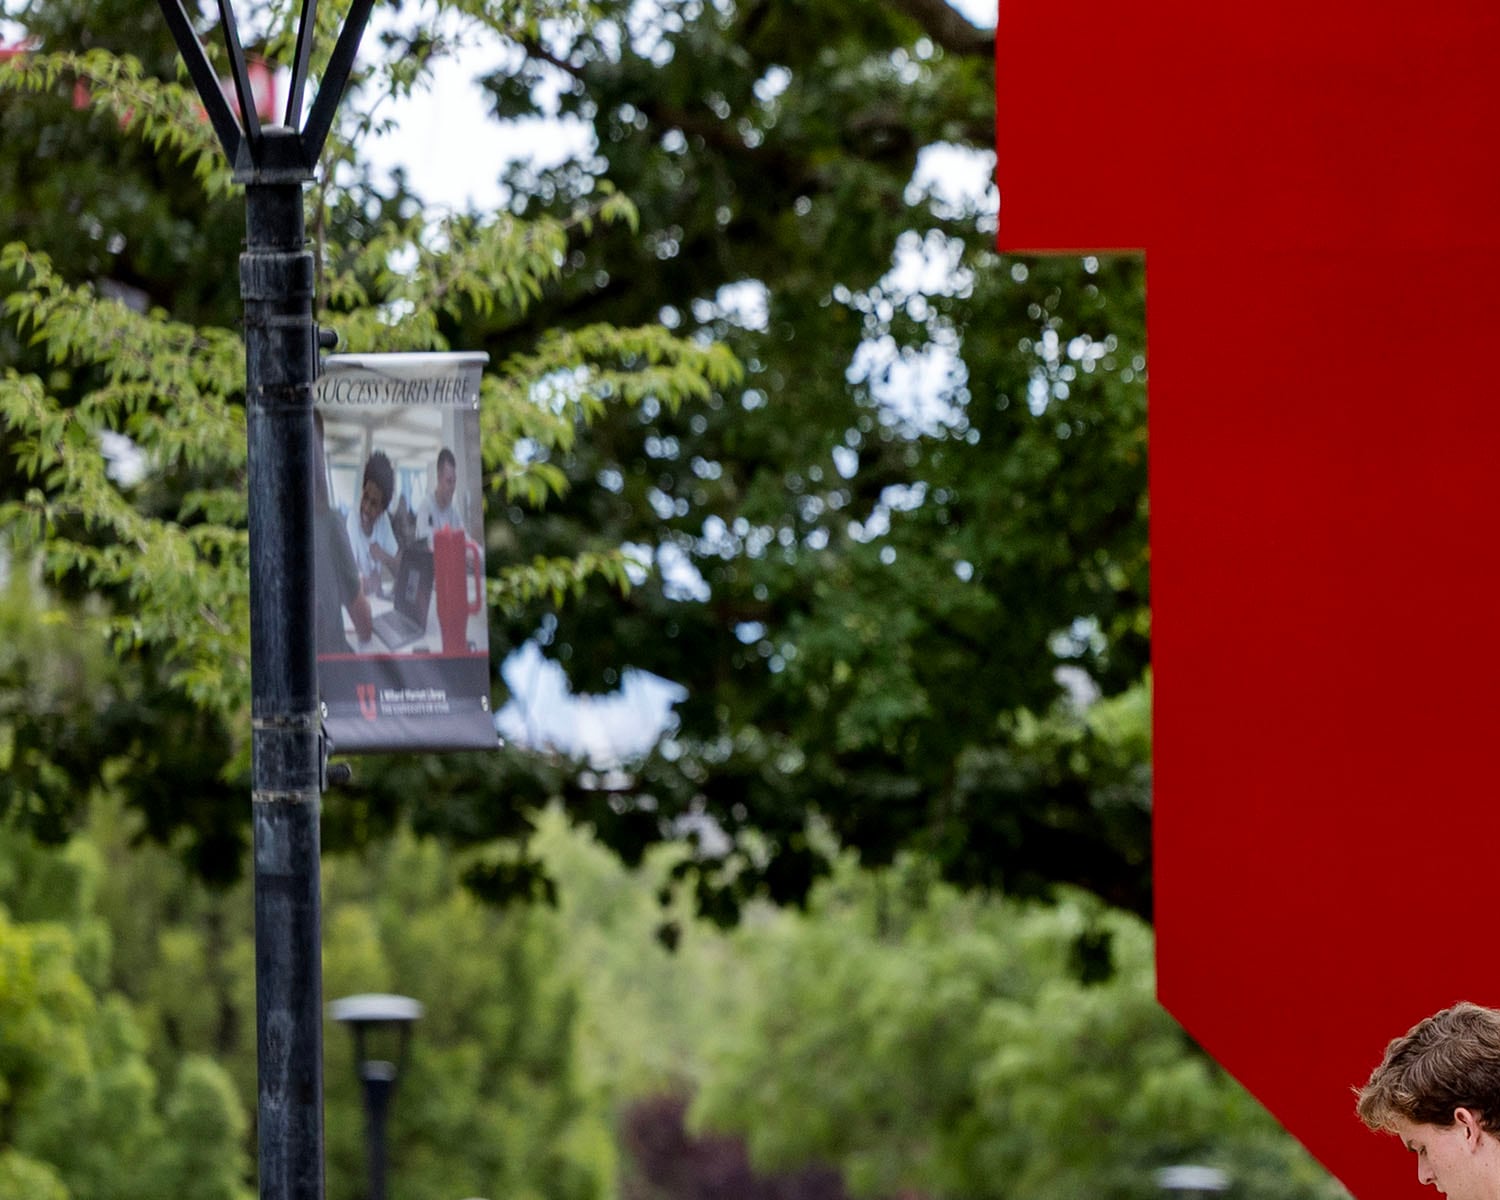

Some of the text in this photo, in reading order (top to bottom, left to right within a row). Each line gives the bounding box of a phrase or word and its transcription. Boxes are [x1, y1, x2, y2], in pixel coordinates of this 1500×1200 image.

[314, 375, 471, 405] SUCCESS STARTS HERE
